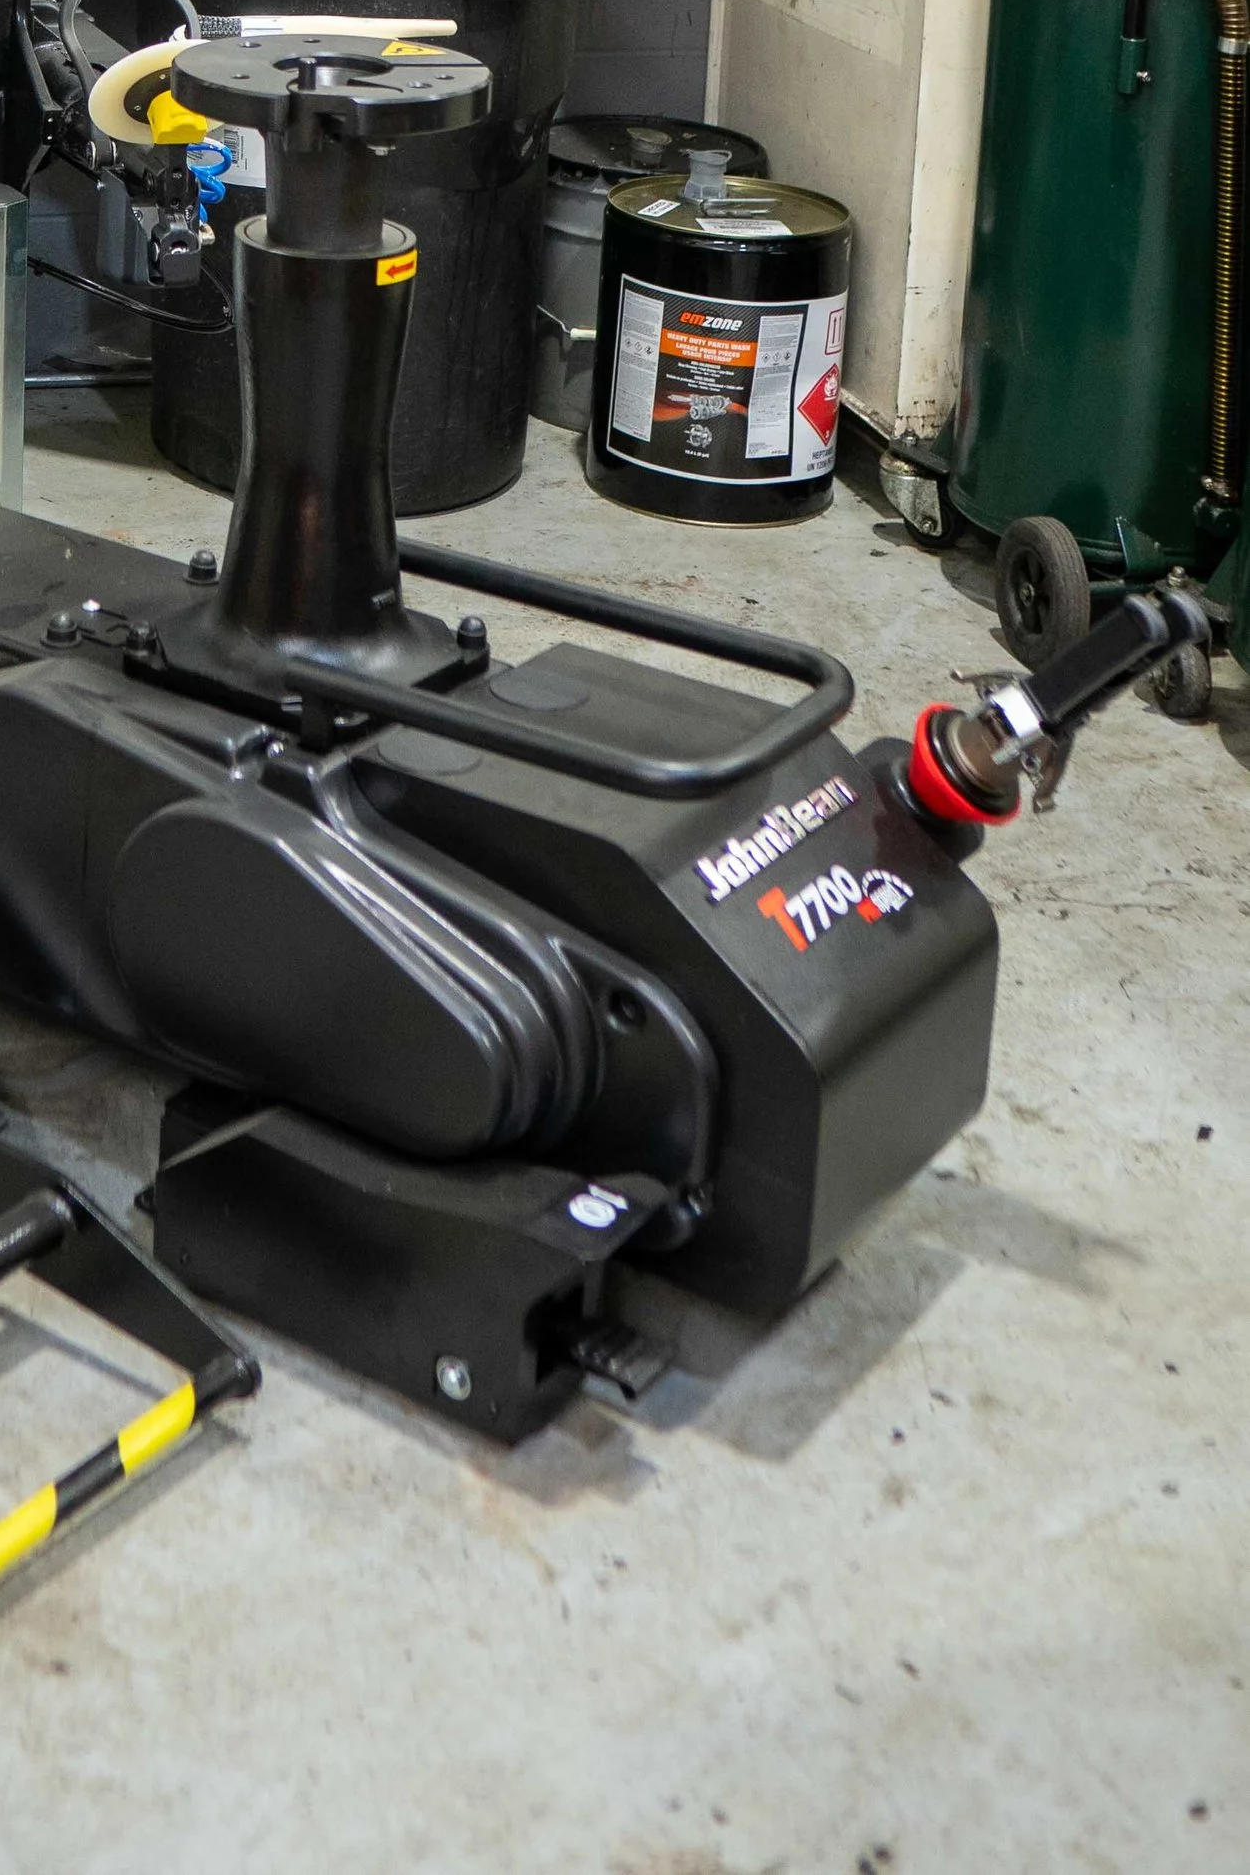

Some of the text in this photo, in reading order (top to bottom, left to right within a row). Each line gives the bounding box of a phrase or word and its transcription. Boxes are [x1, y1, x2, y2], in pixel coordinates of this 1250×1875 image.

[667, 332, 751, 351] HEAVY DUTY PARTS WASH
[680, 312, 743, 331] emzone
[695, 775, 859, 903] JohnBean
[756, 864, 863, 954] T7700
